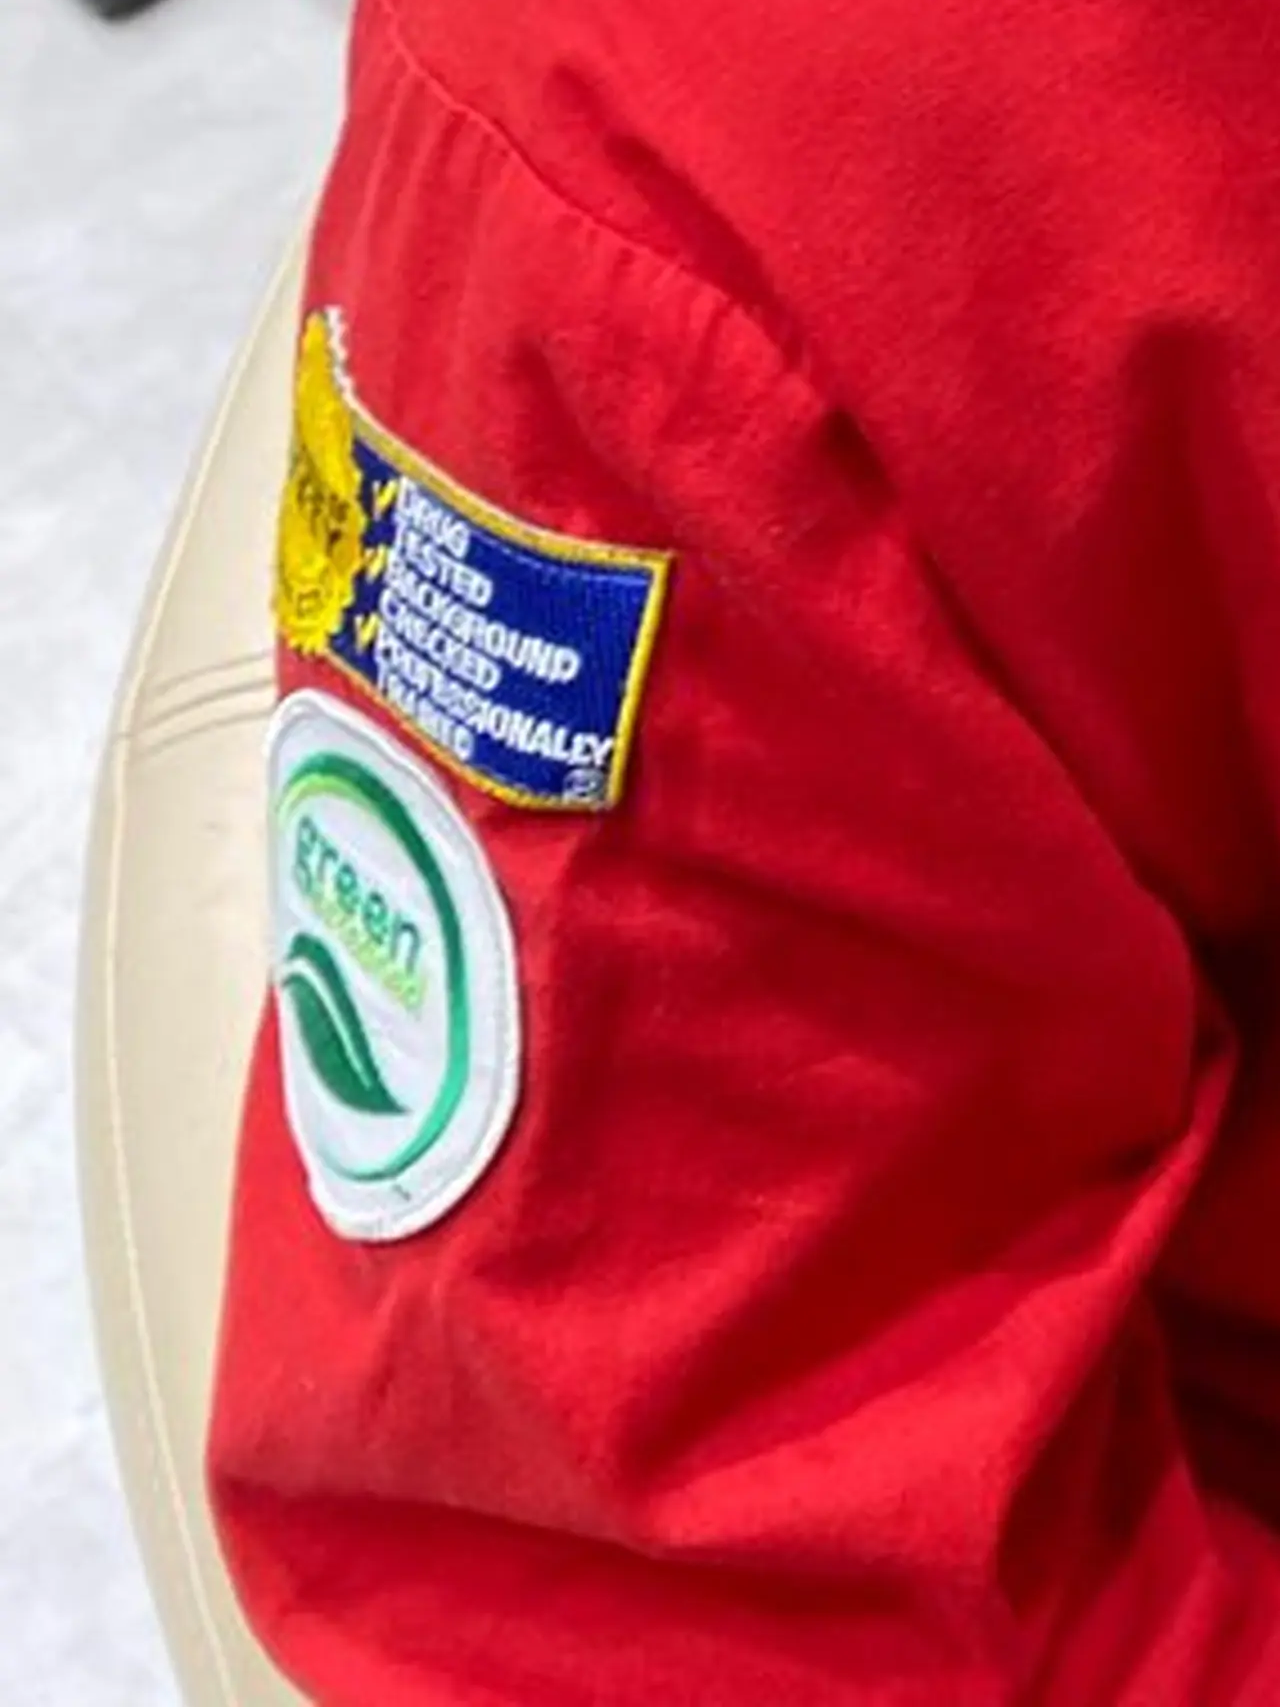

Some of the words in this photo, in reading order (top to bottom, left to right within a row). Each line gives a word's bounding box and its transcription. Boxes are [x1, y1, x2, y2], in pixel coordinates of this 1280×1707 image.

[392, 508, 494, 608] TESTED
[396, 476, 470, 558] DRUG
[379, 587, 501, 691] CHECKED
[385, 548, 581, 684] BACKGROUND
[294, 816, 420, 977] green
